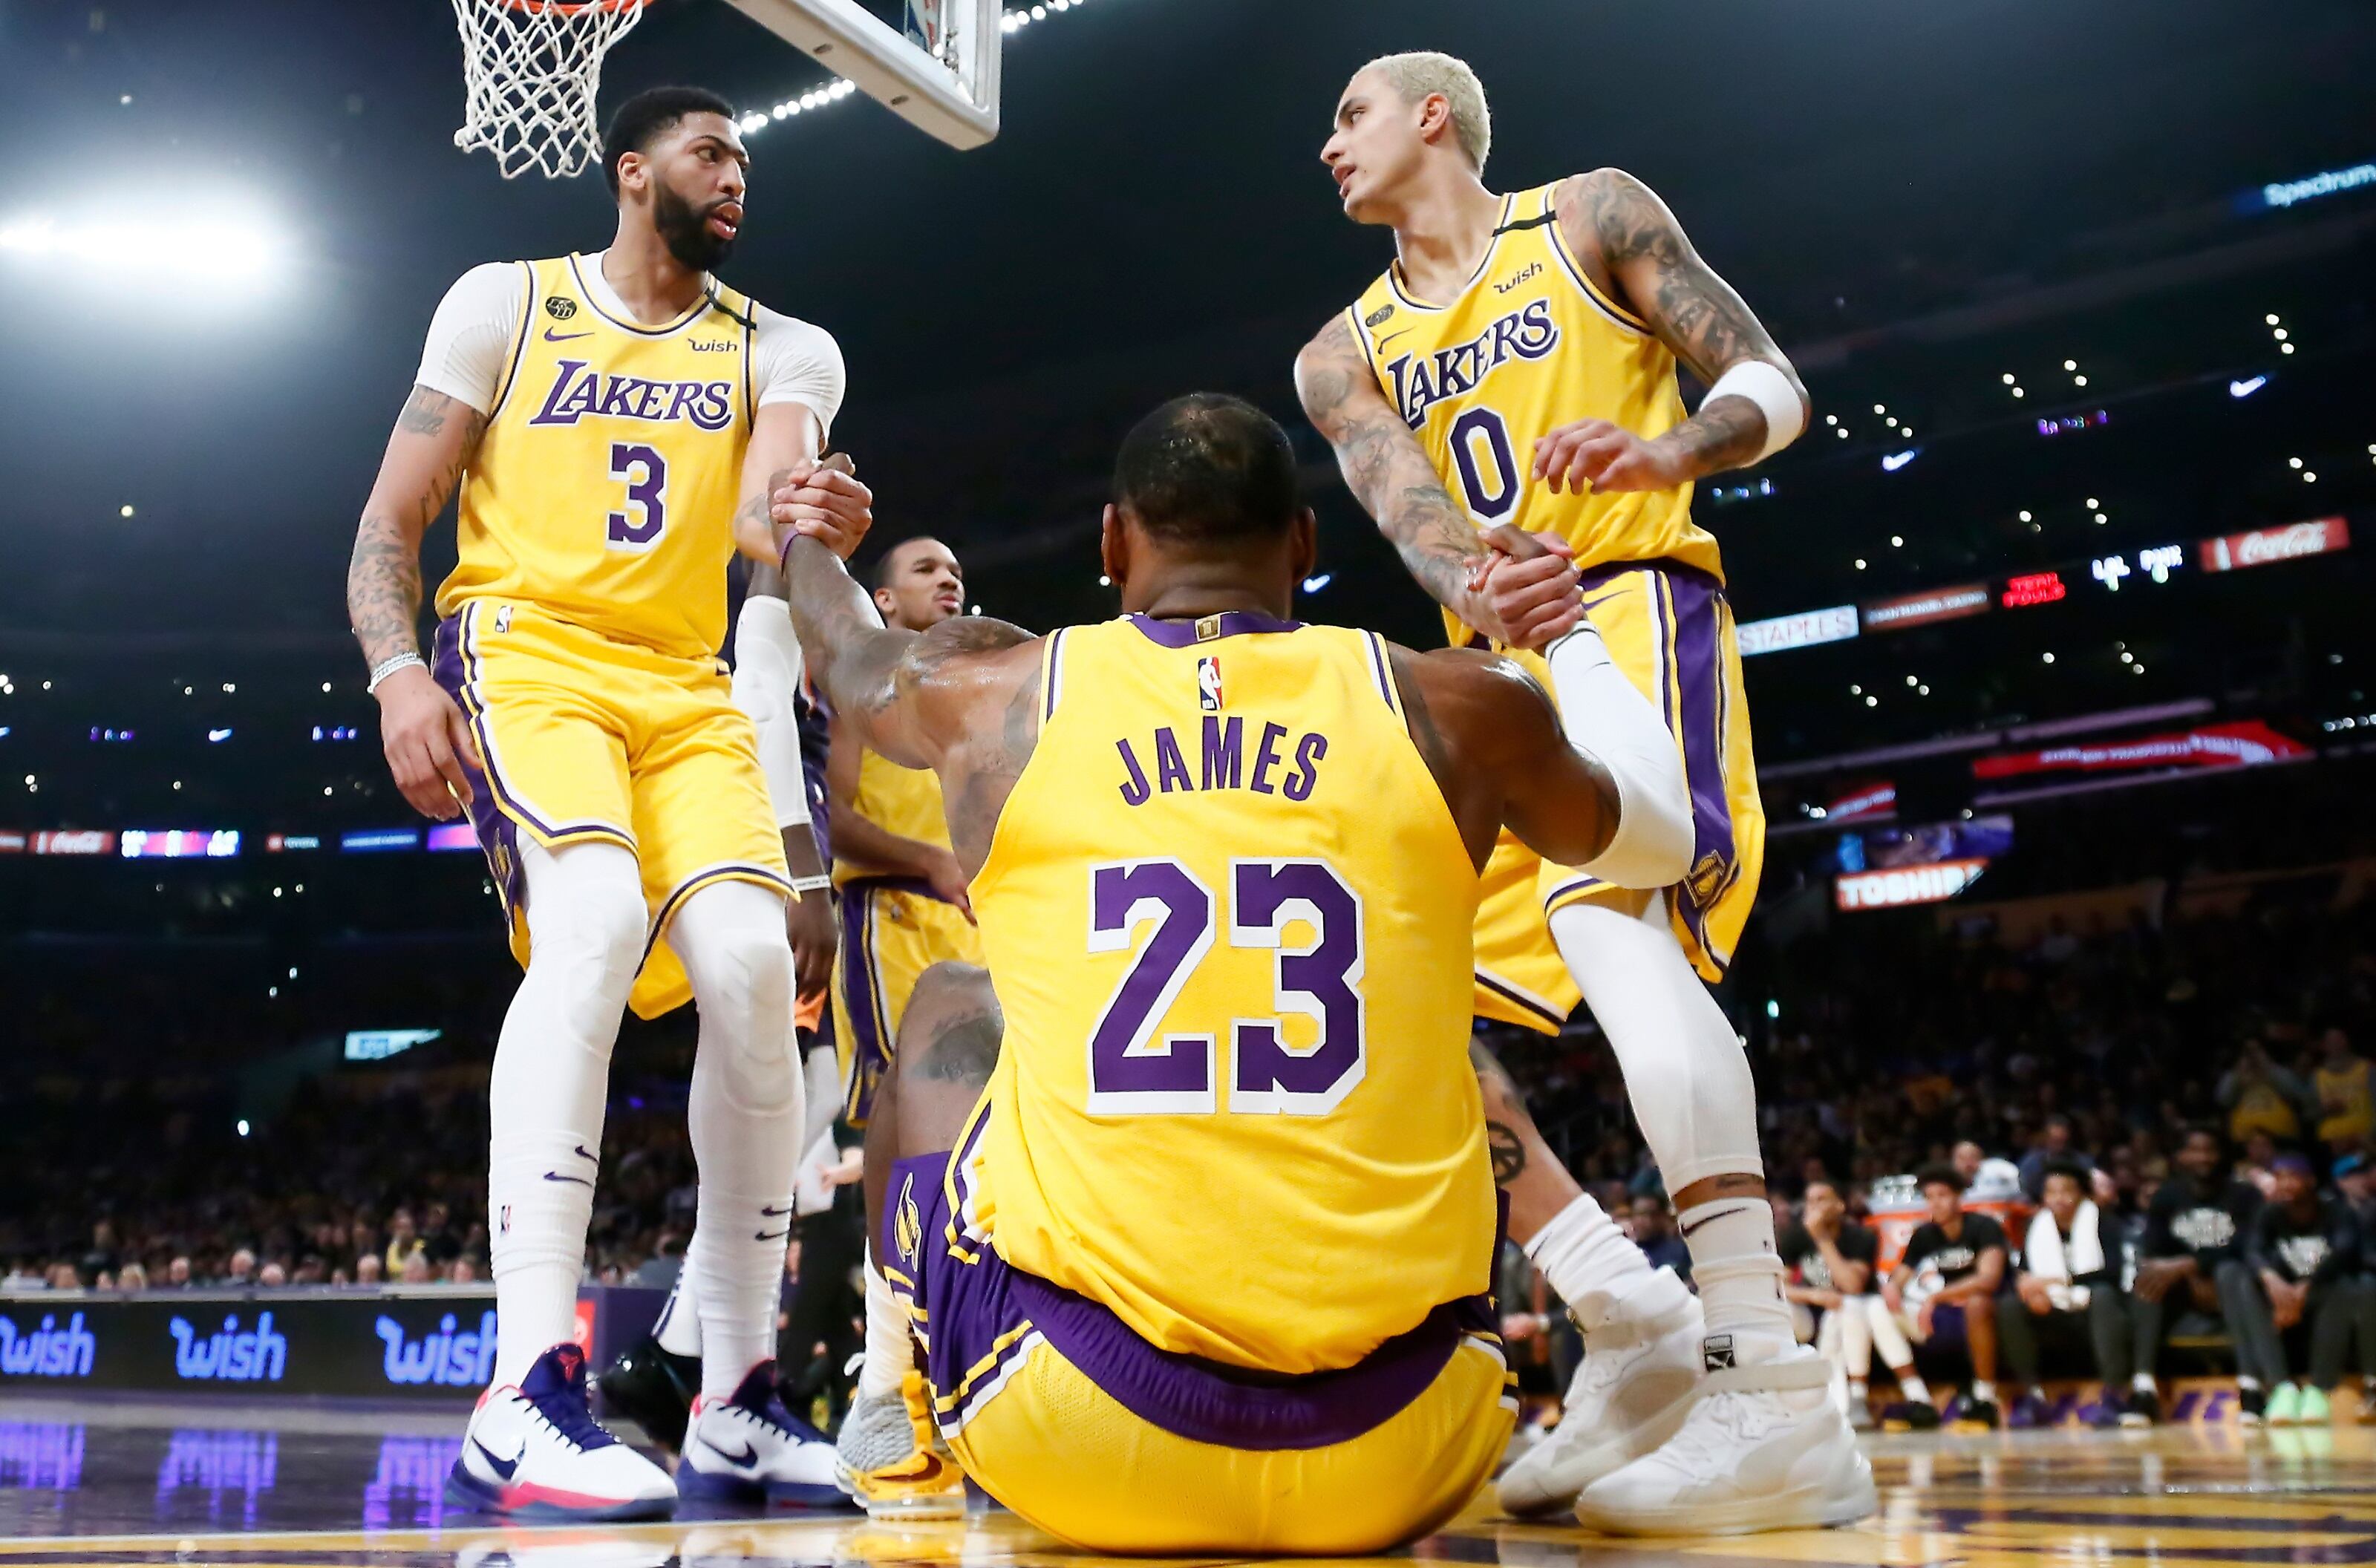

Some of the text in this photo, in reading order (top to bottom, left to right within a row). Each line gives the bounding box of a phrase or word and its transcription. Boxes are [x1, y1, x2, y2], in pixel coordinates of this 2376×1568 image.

[1493, 262, 1543, 294] wish
[688, 338, 738, 353] wish
[1386, 297, 1562, 431] LAKERS
[527, 359, 734, 431] LAKERS
[606, 441, 668, 552] 3
[1449, 405, 1520, 528] 0
[1116, 716, 1328, 806] JAMES
[1087, 856, 1366, 1115] 23
[0, 1311, 95, 1377] wish
[170, 1311, 287, 1381] wish
